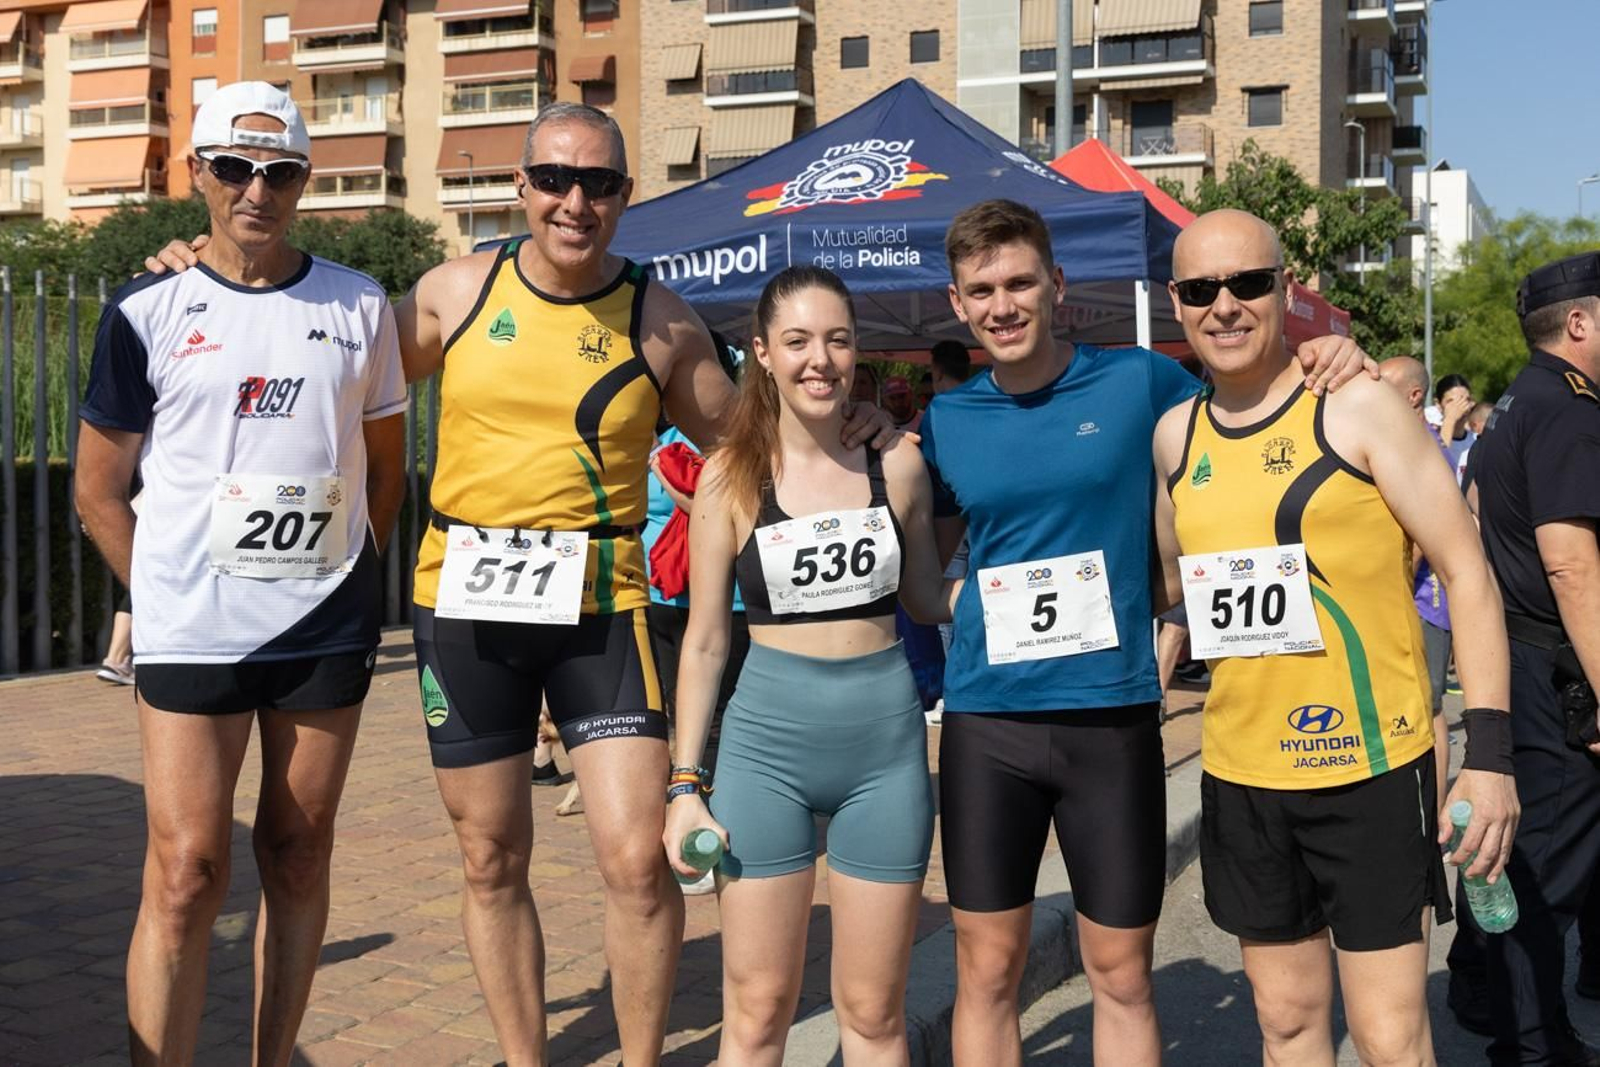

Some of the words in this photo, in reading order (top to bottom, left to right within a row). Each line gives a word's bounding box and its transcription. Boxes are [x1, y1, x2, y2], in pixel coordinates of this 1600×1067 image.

[823, 139, 915, 158] mupol
[812, 224, 908, 247] Mutualidad
[652, 234, 767, 285] mupol
[813, 252, 835, 270] de
[839, 251, 853, 268] la
[857, 246, 921, 268] Policía
[171, 342, 223, 361] Santander
[332, 335, 362, 352] mupol
[235, 509, 333, 551] 207
[236, 555, 254, 563] JUAN
[254, 556, 277, 564] PEDRO
[277, 557, 303, 565] CAMPOS
[790, 536, 876, 587] 536
[464, 556, 557, 597] 511
[801, 588, 821, 599] PAULA
[820, 584, 855, 598] RODRIGUEZ
[1030, 592, 1058, 633] 5
[1211, 583, 1286, 630] 510
[1016, 639, 1036, 648] DANIEL
[1240, 632, 1271, 641] RODRIGUEZ
[592, 716, 646, 727] HYUNDAI
[585, 726, 639, 741] JACARSA
[1280, 735, 1361, 752] HYUNDAI
[1292, 754, 1358, 769] JACARSA
